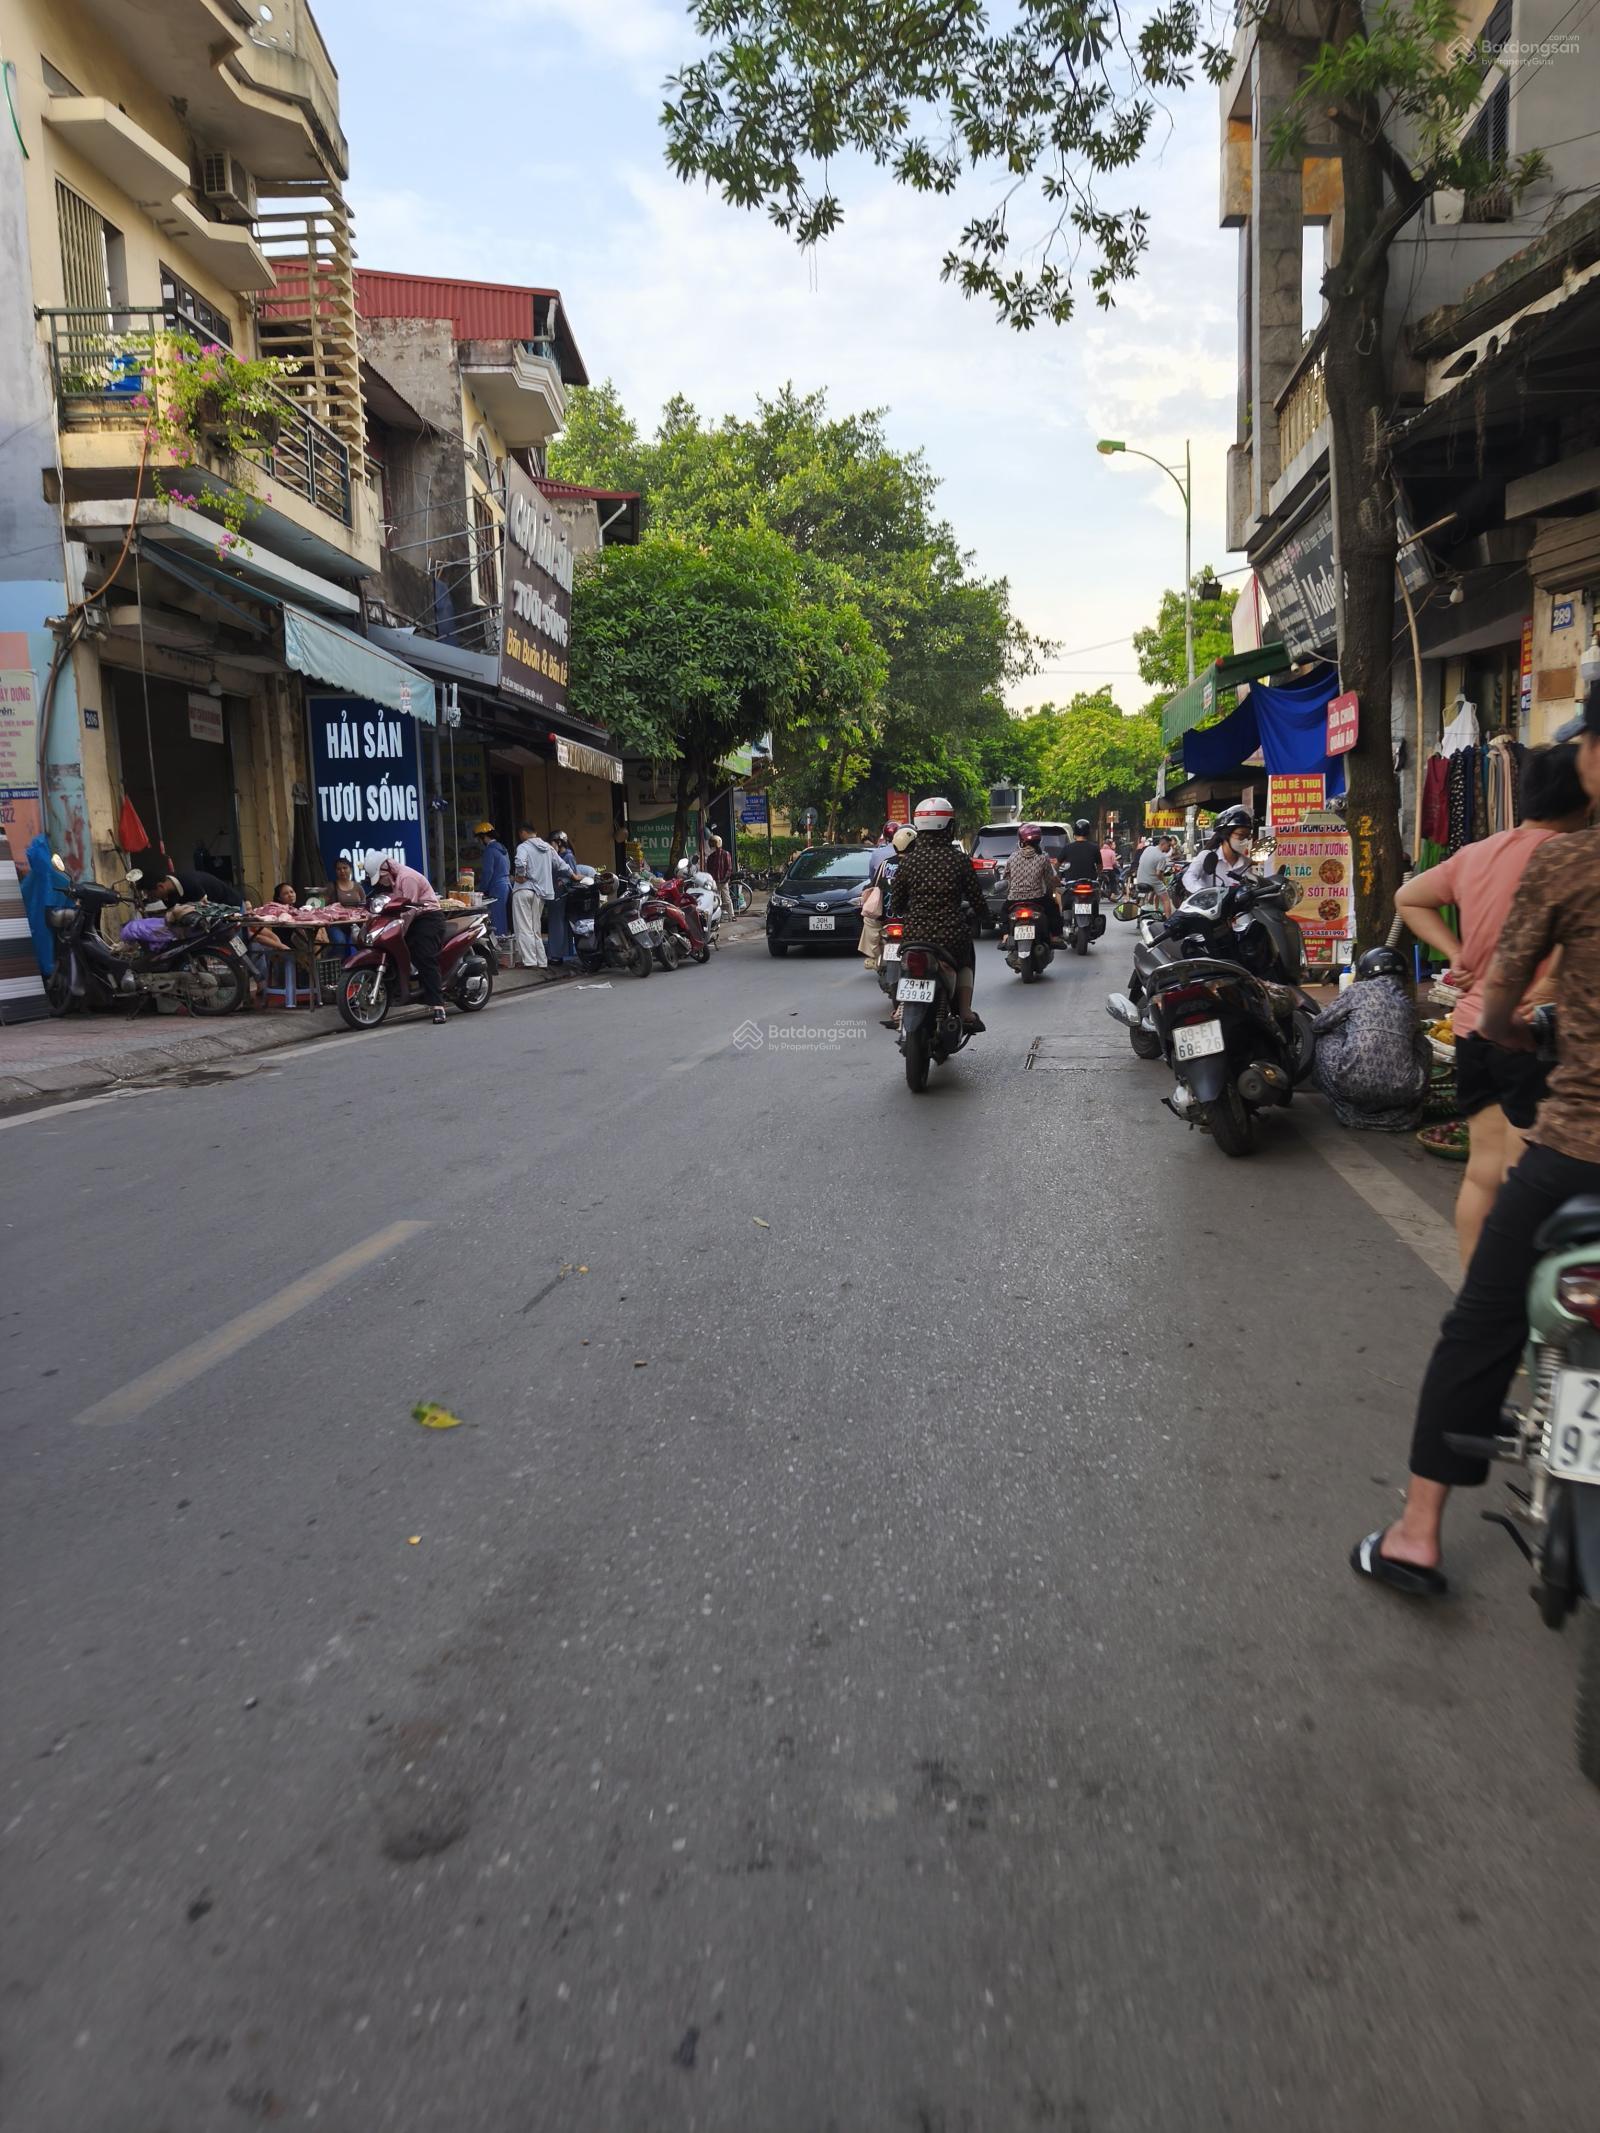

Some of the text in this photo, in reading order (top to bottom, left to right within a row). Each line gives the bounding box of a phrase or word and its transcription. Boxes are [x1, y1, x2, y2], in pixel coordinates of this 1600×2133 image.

[1552, 606, 1572, 626] 289
[506, 626, 521, 661] Bán
[522, 637, 541, 673] Buôn
[541, 648, 548, 676] &
[85, 711, 98, 726] 206
[326, 709, 403, 759] HẢI SẢN
[1302, 778, 1321, 789] THUI
[318, 772, 419, 823] TƯƠI SỐNG
[1293, 792, 1305, 804] TAI
[1306, 792, 1322, 803] HEO
[1273, 807, 1296, 817] NEM
[662, 835, 697, 849] OH
[904, 980, 931, 991] 29-N1
[899, 989, 932, 1001] 539.82
